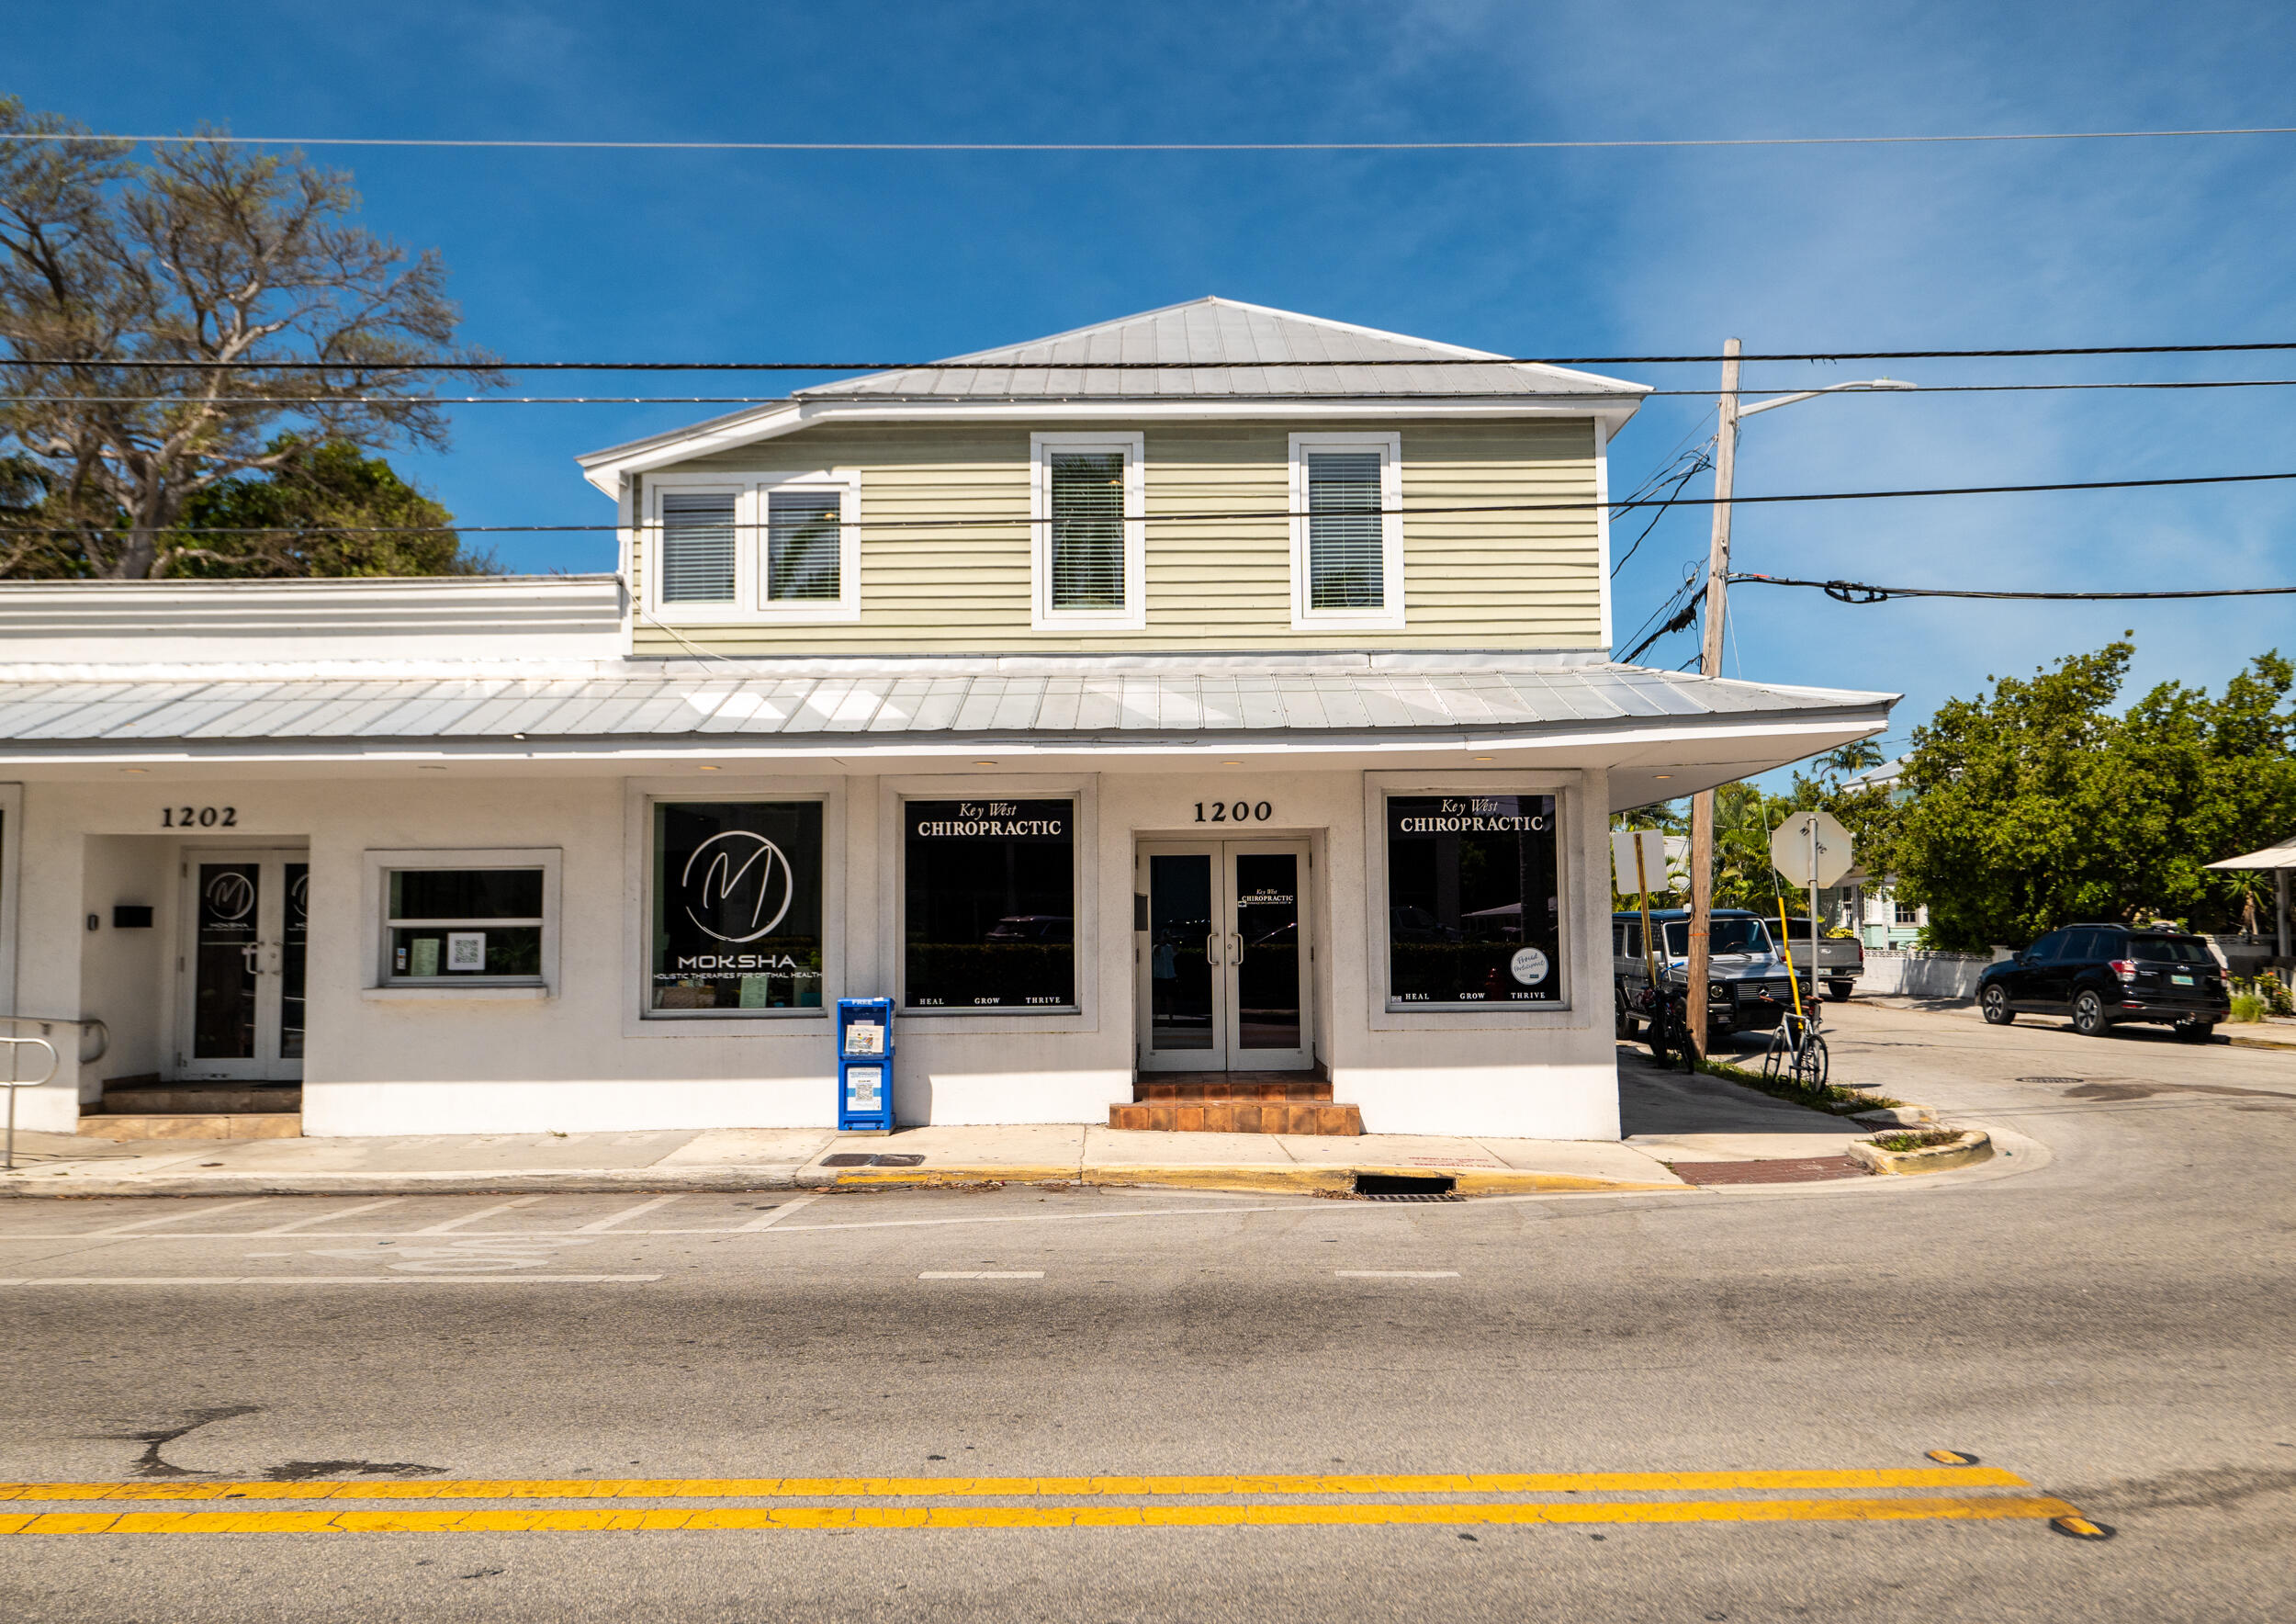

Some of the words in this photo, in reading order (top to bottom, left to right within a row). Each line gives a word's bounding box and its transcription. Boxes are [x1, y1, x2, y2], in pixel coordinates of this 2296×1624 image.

[959, 803, 984, 820] Key
[990, 802, 1017, 817] West
[1194, 801, 1272, 822] 1200
[1441, 799, 1466, 817] Key
[1471, 798, 1499, 813] West
[162, 806, 238, 828] 1202
[1401, 816, 1544, 832] CHIROPRACTIC
[918, 820, 1063, 836] CHIROPRACTIC
[678, 954, 797, 969] MOKSHA
[691, 972, 736, 980] THERAPIES
[974, 997, 1001, 1005] GROW
[1025, 996, 1062, 1004] THRIVE
